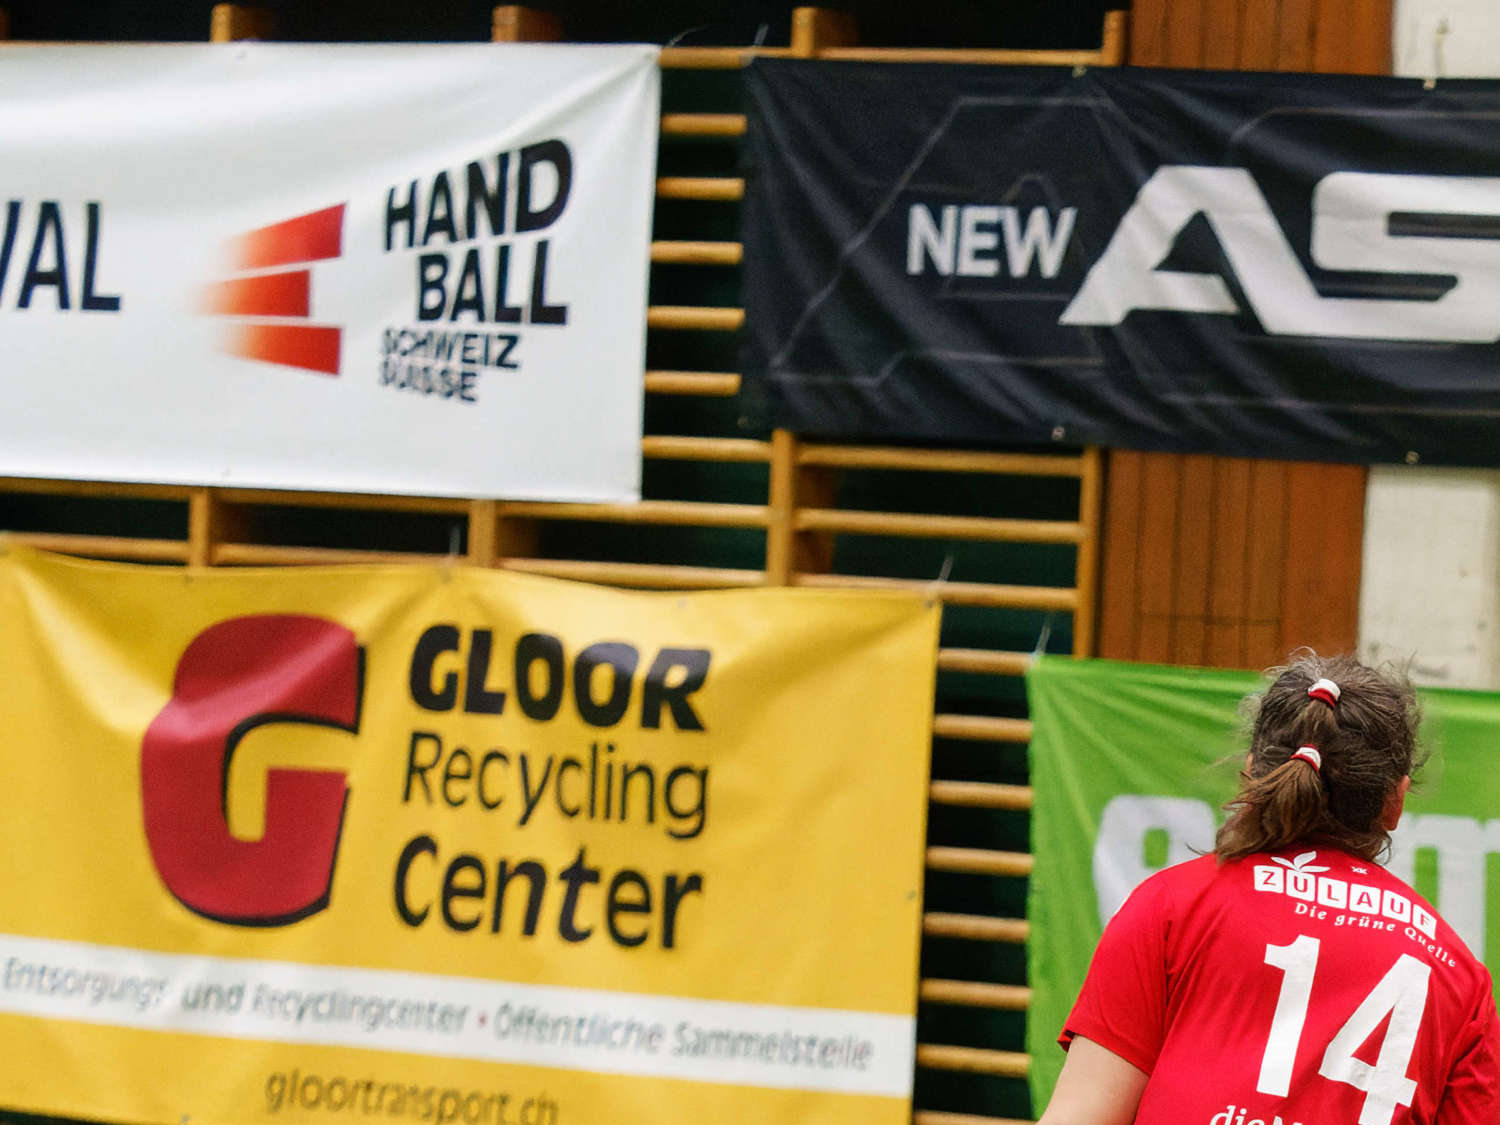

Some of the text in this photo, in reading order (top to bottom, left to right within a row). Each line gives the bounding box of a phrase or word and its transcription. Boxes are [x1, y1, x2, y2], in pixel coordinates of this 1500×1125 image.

[384, 139, 573, 251] HAND
[418, 238, 567, 325] BALL
[907, 203, 1077, 279] NEW
[380, 329, 519, 369] SCHWEIZ
[409, 623, 713, 732] GLOOR
[403, 731, 709, 840] Recycling
[394, 834, 703, 951] Center
[1254, 865, 1437, 940] ZULAUF
[1294, 902, 1457, 967] Die grüne Quelle
[181, 982, 245, 1012] und
